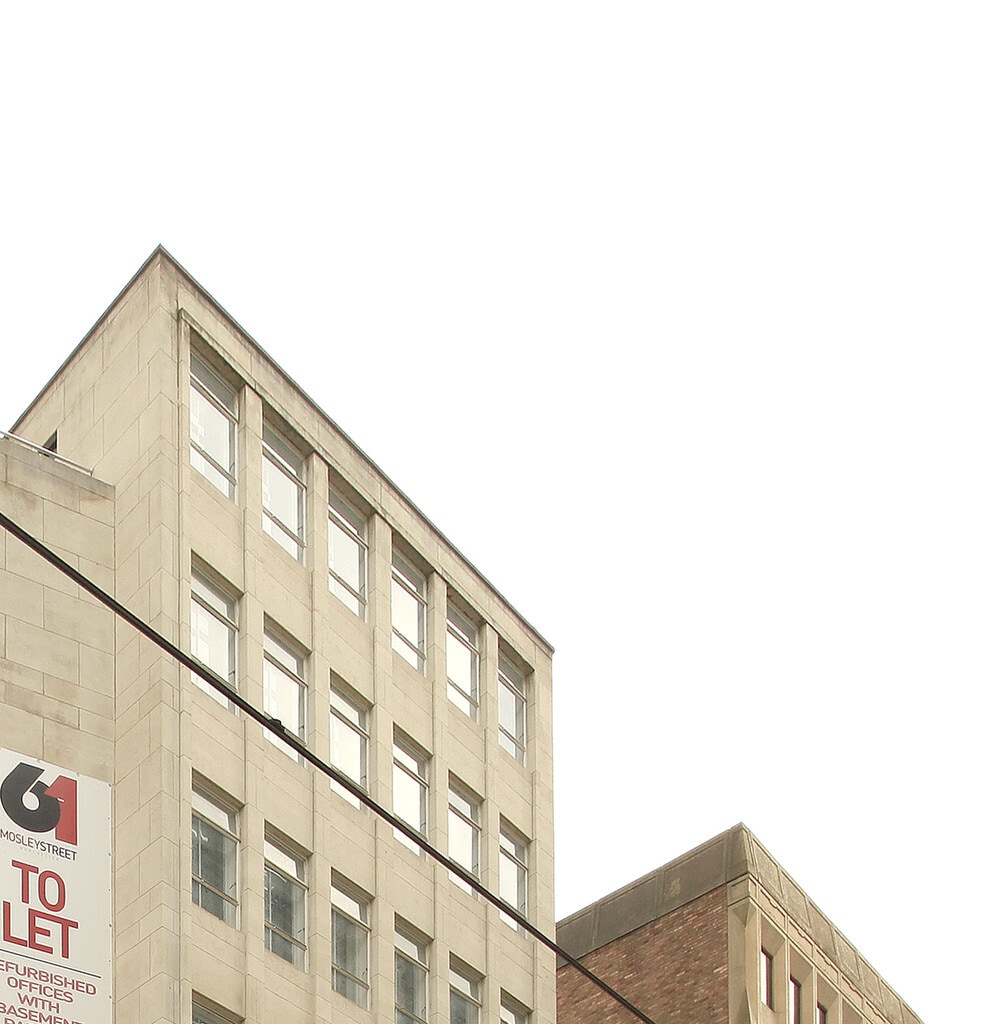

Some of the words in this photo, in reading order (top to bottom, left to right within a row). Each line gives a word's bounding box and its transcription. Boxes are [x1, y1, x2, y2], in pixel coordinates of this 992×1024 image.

[0, 762, 77, 845] 61
[12, 860, 66, 912] TO
[3, 901, 78, 959] LET
[7, 976, 73, 1003] OFFICES
[17, 993, 60, 1014] WITH
